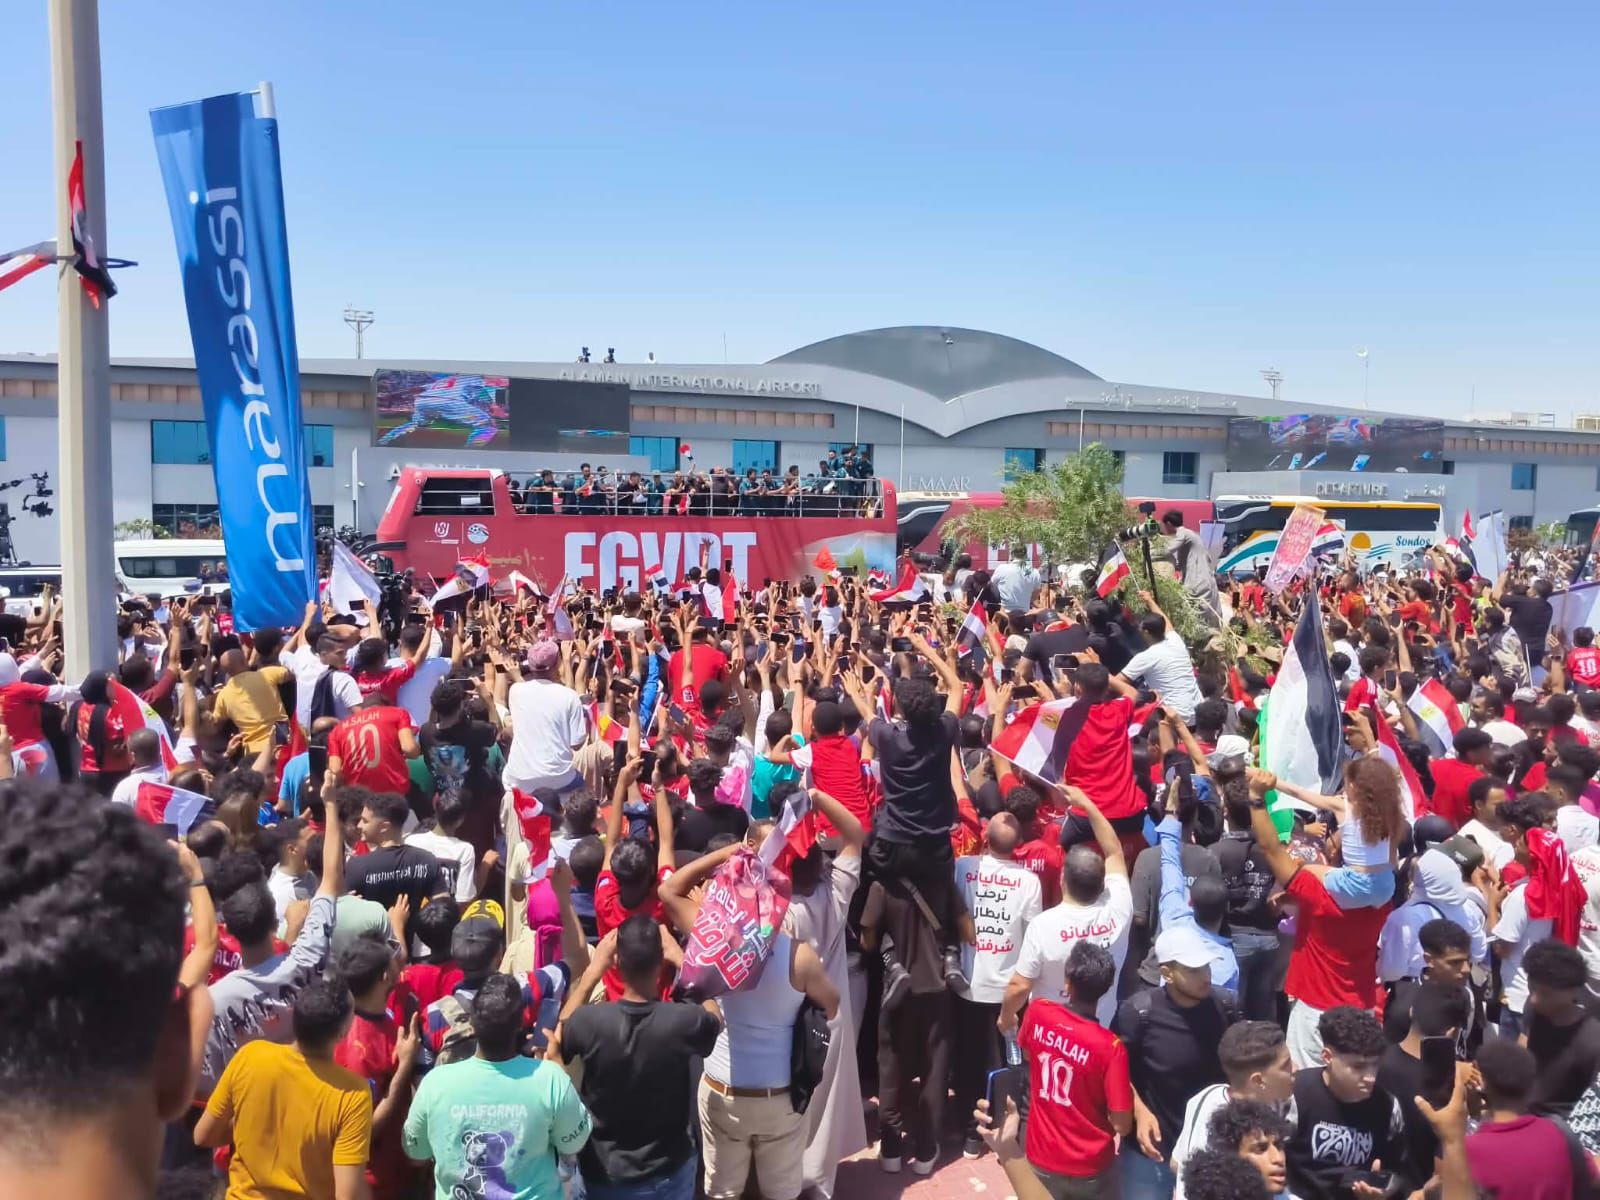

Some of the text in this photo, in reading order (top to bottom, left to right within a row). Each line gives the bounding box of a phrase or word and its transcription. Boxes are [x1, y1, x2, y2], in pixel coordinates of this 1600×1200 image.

[189, 186, 304, 572] marassi
[636, 374, 753, 391] INTERNATIONAL
[756, 378, 821, 394] AIRPORT
[908, 474, 971, 491] EMAAR
[1315, 481, 1390, 497] DEPARTURE
[1395, 535, 1431, 546] Sondos
[564, 530, 757, 600] EGYPT
[346, 722, 381, 770] 10
[965, 871, 1021, 890] ايطاليانو
[975, 889, 1008, 902] ترحب
[976, 925, 1004, 936] مصر
[1060, 917, 1117, 944] ايطاليانو
[1032, 1023, 1090, 1066] M.SALAH
[1037, 1050, 1074, 1108] 10
[449, 1103, 529, 1119] CALIFORNIA
